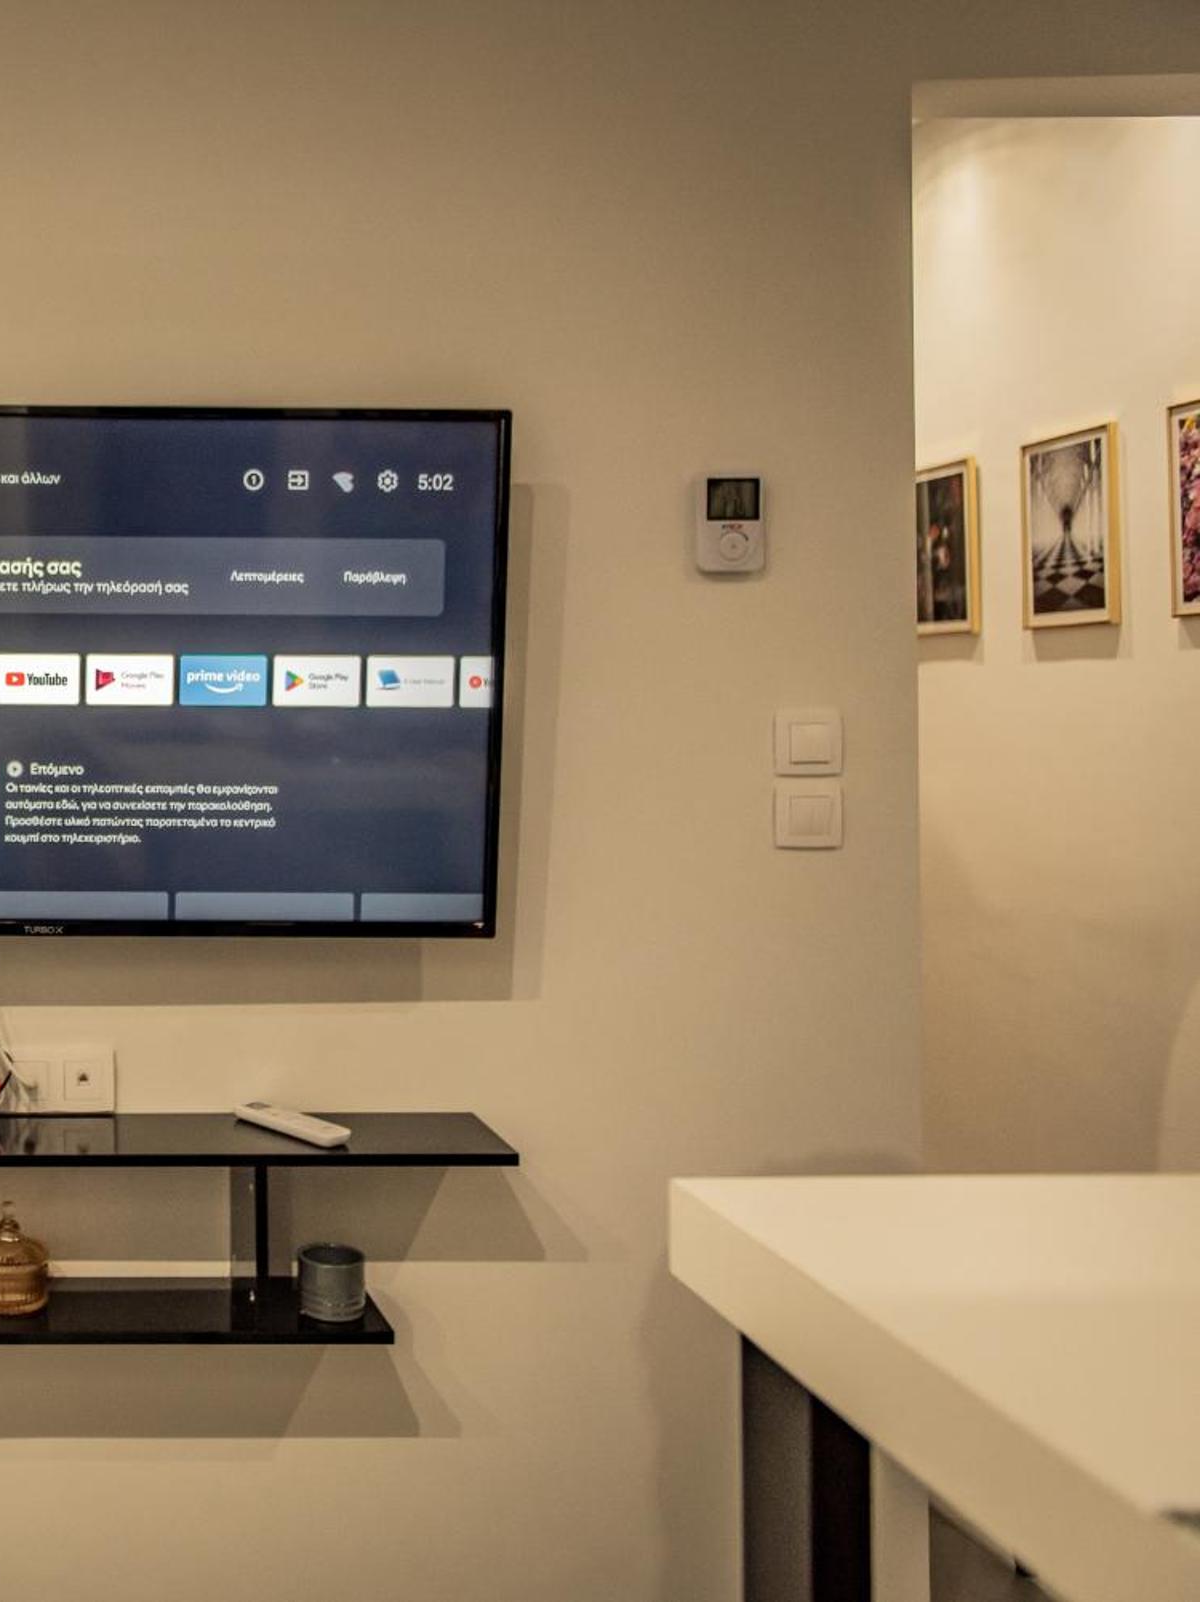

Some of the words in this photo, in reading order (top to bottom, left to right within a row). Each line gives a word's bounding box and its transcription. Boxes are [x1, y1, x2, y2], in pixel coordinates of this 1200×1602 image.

[0, 473, 19, 485] και
[21, 470, 61, 486] άλλων
[418, 474, 454, 492] 5:02
[47, 562, 82, 579] σας
[230, 569, 304, 585] Λεπτομέρειες
[343, 570, 406, 585] Παράβλεψη
[21, 578, 72, 597] πλήρως
[73, 582, 96, 596] την
[96, 580, 163, 597] τηλεόρασή
[164, 583, 189, 597] σας
[26, 672, 68, 687] YouTube
[186, 669, 224, 684] prime
[226, 668, 260, 683] video
[30, 762, 85, 777] Επόμενο
[55, 784, 70, 793] και
[82, 783, 144, 795] τηλεοπτικές
[145, 783, 196, 796] εκπομπές
[196, 784, 212, 794] θα
[212, 784, 279, 796] εμφανίζονται
[5, 800, 54, 812] αυτόματα
[81, 801, 98, 812] για
[99, 801, 111, 810] να
[169, 802, 187, 812] την
[220, 818, 231, 827] το
